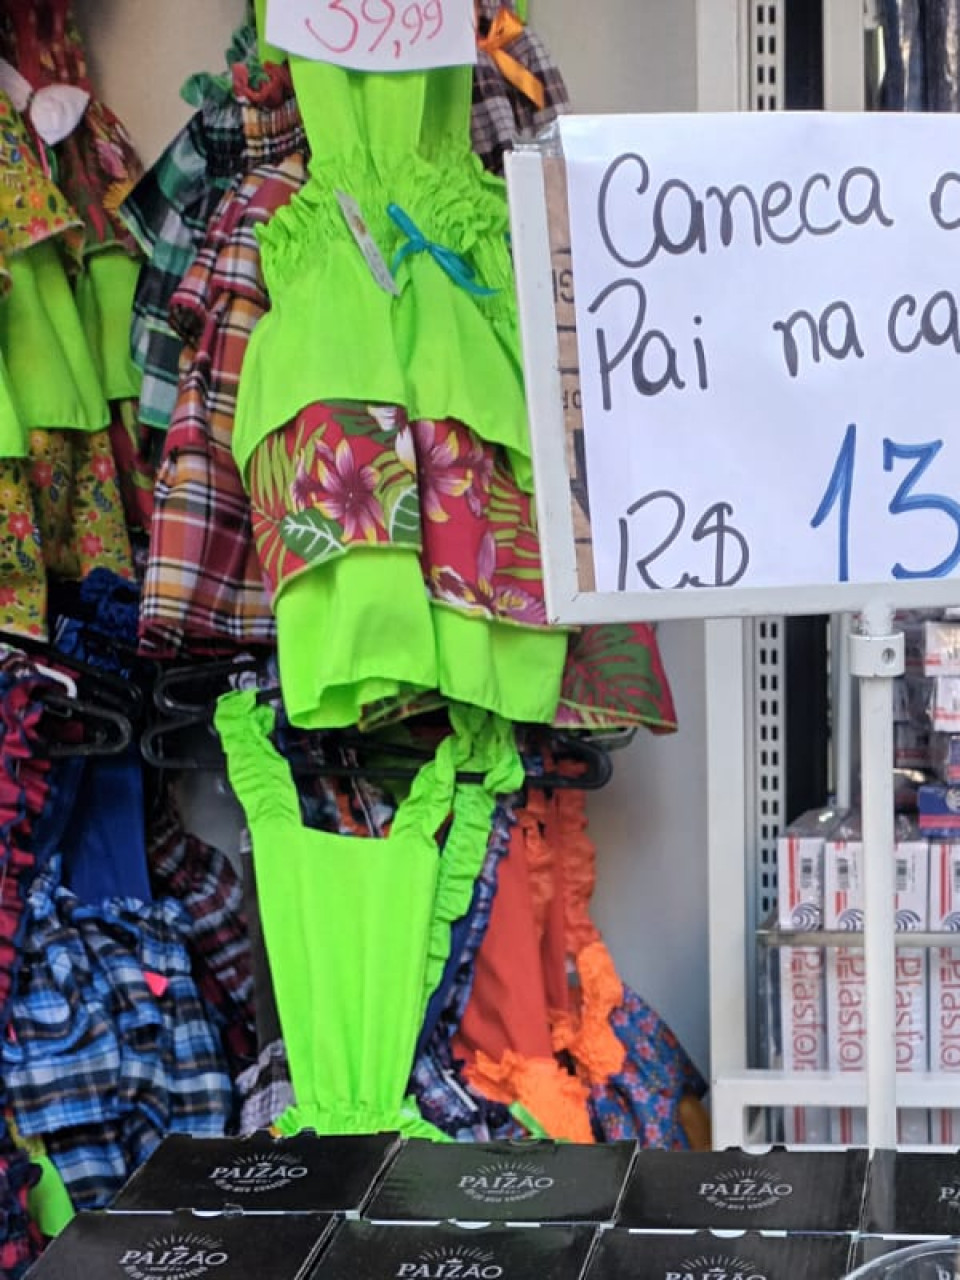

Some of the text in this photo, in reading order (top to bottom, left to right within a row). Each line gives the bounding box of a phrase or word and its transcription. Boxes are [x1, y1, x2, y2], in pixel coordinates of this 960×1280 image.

[304, 0, 444, 58] 39,99
[598, 152, 894, 269] Caneca
[586, 277, 708, 412] Pai
[772, 300, 865, 378] na
[617, 490, 750, 591] R$
[792, 950, 827, 1070] Plasfor
[836, 956, 866, 1072] Plasfo
[896, 957, 924, 1072] Plasfo
[209, 1165, 308, 1179] PAIZÃO
[699, 1181, 793, 1196] PAIZÃO
[119, 1250, 228, 1266] PAIZÃO
[396, 1263, 504, 1279] PAIZÃO
